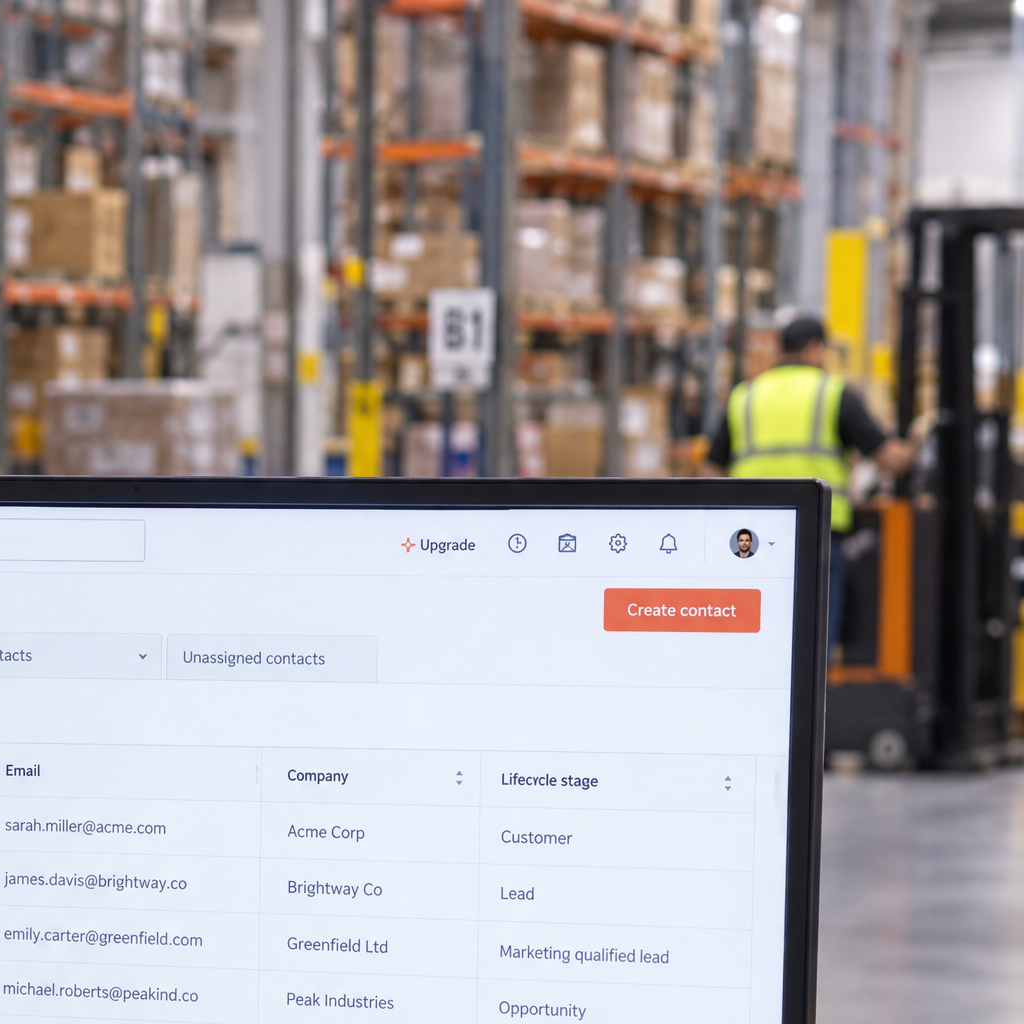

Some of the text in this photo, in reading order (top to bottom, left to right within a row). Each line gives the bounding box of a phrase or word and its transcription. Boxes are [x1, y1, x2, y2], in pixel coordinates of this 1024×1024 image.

[444, 308, 483, 351] B1
[420, 538, 476, 554] Upgrade
[627, 602, 737, 617] Create contact
[183, 650, 326, 667] Unassigned contacts
[5, 764, 41, 776] Email
[287, 768, 349, 785] Company
[501, 772, 599, 790] Lifecycle stage
[5, 818, 166, 835] sarah.miller@acme.com
[287, 824, 365, 842] Acme Corp
[501, 829, 573, 844] Customer
[3, 871, 188, 892] james.davis@brightway.co
[287, 880, 383, 898] Brightway Co
[500, 886, 535, 900] Lead
[3, 926, 203, 946] emily.carter@greenfield.com
[286, 936, 388, 953] Greenfield Ltd
[499, 944, 670, 964] Marketing qualified lead
[3, 981, 199, 1002] michael.roberts@peakind.co
[286, 992, 395, 1009] Peak Industries
[498, 1000, 587, 1020] Opportunity
